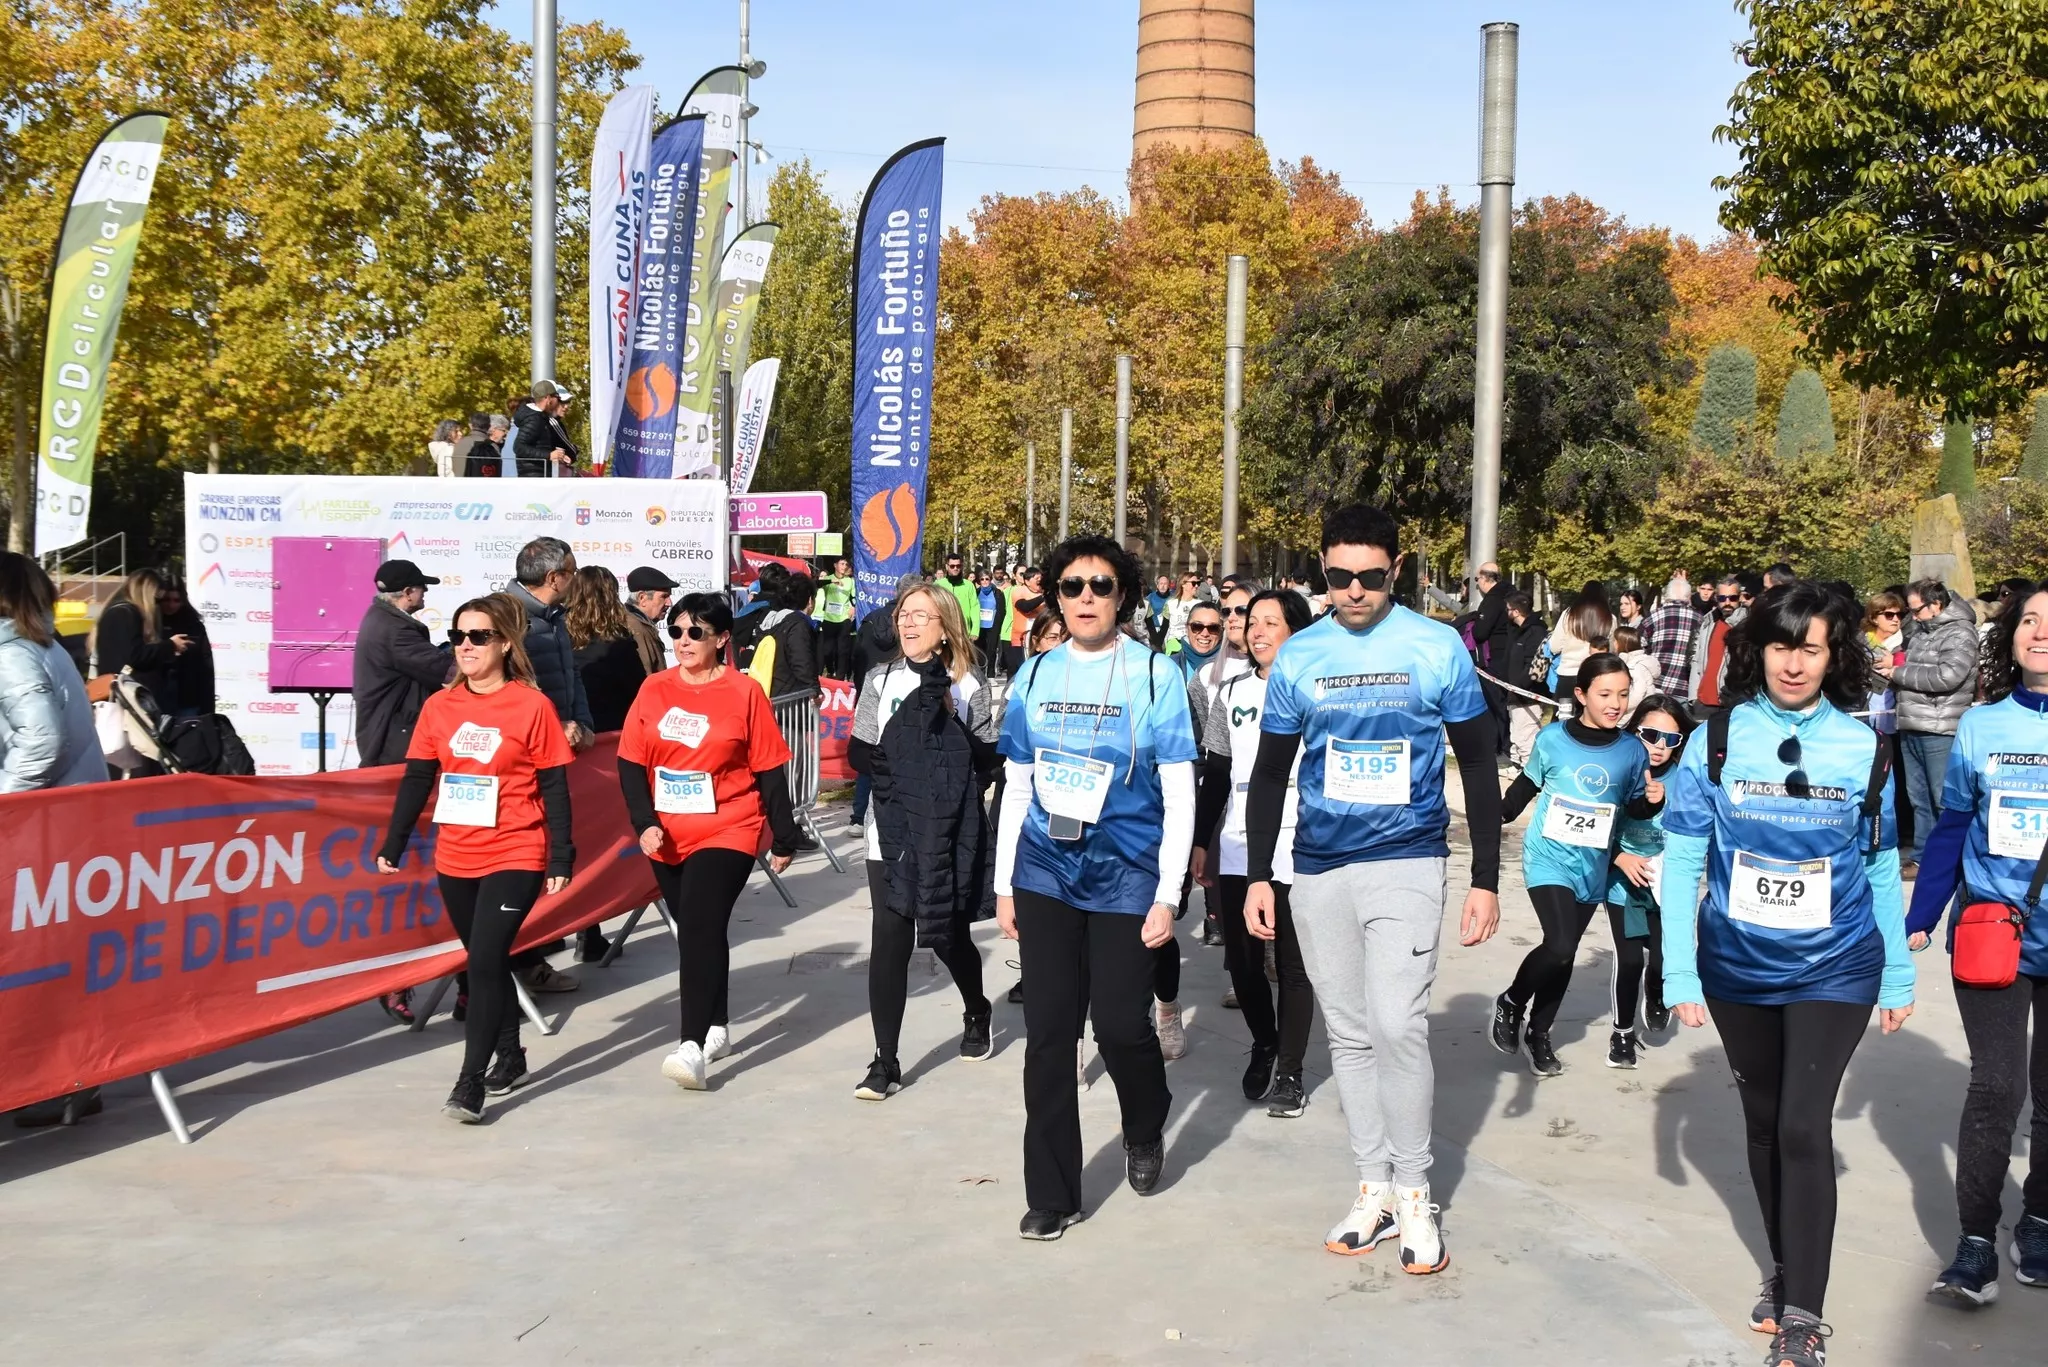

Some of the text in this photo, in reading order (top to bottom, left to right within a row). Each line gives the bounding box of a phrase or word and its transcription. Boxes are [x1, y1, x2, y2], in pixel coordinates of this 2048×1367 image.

[99, 155, 149, 181] RCD
[643, 163, 676, 255] Fortuño
[616, 203, 632, 283] CUNA
[666, 162, 689, 351] centro de podología
[733, 248, 765, 266] RCD
[634, 263, 665, 351] Nicolás
[49, 197, 125, 462] RCDcircular
[871, 209, 910, 467] Nicolás Fortuño
[908, 346, 924, 375] de
[622, 427, 673, 440] 659 827 971
[738, 412, 752, 450] CUNA
[908, 387, 922, 467] centro
[739, 397, 763, 481] DEPORTISTAS
[620, 442, 671, 457] 974 401 867
[200, 493, 281, 505] CARRERA EMPRESAS
[200, 504, 281, 522] MONZÓN CM
[325, 512, 370, 522] SPORT
[595, 508, 633, 518] Monzón
[671, 510, 714, 518] DIPUTACIÓN
[737, 514, 814, 529] Labordeta
[414, 537, 460, 546] alumbra
[573, 541, 633, 552] ESPIAS
[645, 539, 702, 549] Automóviles
[652, 548, 714, 560] CABRERO
[857, 570, 899, 586] 659 827
[1328, 673, 1409, 687] PROGRAMACIÓN
[1328, 687, 1409, 698] INTEGRAL
[1316, 699, 1409, 712] software para crecer
[1067, 729, 1087, 738] para
[1340, 755, 1397, 774] 3195
[1045, 766, 1097, 792] 3205
[1349, 773, 1383, 781] NESTOR
[448, 786, 486, 802] 3085
[664, 782, 703, 796] 3086
[1055, 784, 1075, 794] OLGA
[1565, 813, 1596, 830] 724
[1731, 810, 1843, 826] software para crecer
[1570, 826, 1584, 834] MIA
[11, 818, 306, 932] MONZÓN
[1756, 876, 1805, 899] 679
[85, 918, 167, 995] DE
